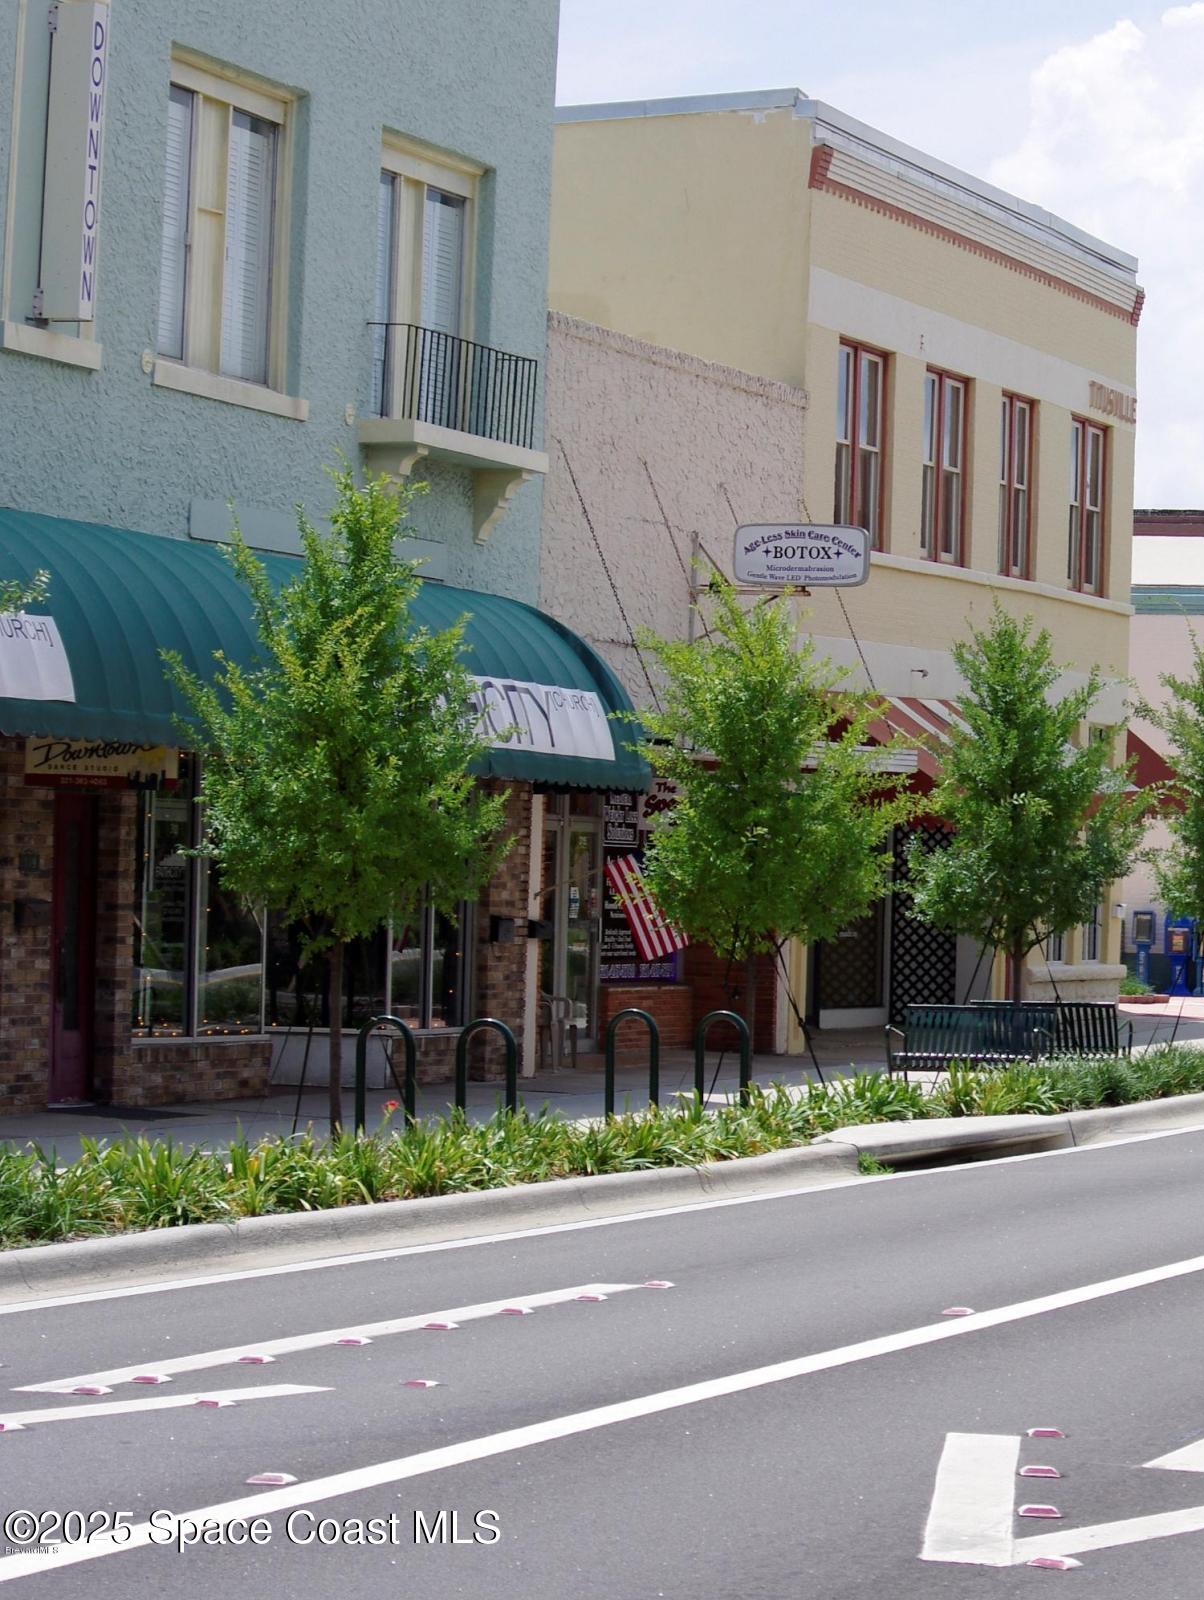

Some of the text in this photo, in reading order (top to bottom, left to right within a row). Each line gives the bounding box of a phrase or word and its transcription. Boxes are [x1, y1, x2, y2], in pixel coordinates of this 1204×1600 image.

[81, 20, 105, 302] DOWNTOWN
[784, 529, 807, 540] Skin
[807, 530, 831, 543] Care
[831, 536, 863, 559] Center
[772, 545, 833, 560] BOTOX
[766, 564, 835, 573] Microdermabrasion
[768, 573, 786, 581] Wave
[0, 618, 54, 648] URCH]
[32, 741, 155, 769] Downtown
[47, 763, 119, 772] DANCE STUDIO
[656, 781, 677, 794] The
